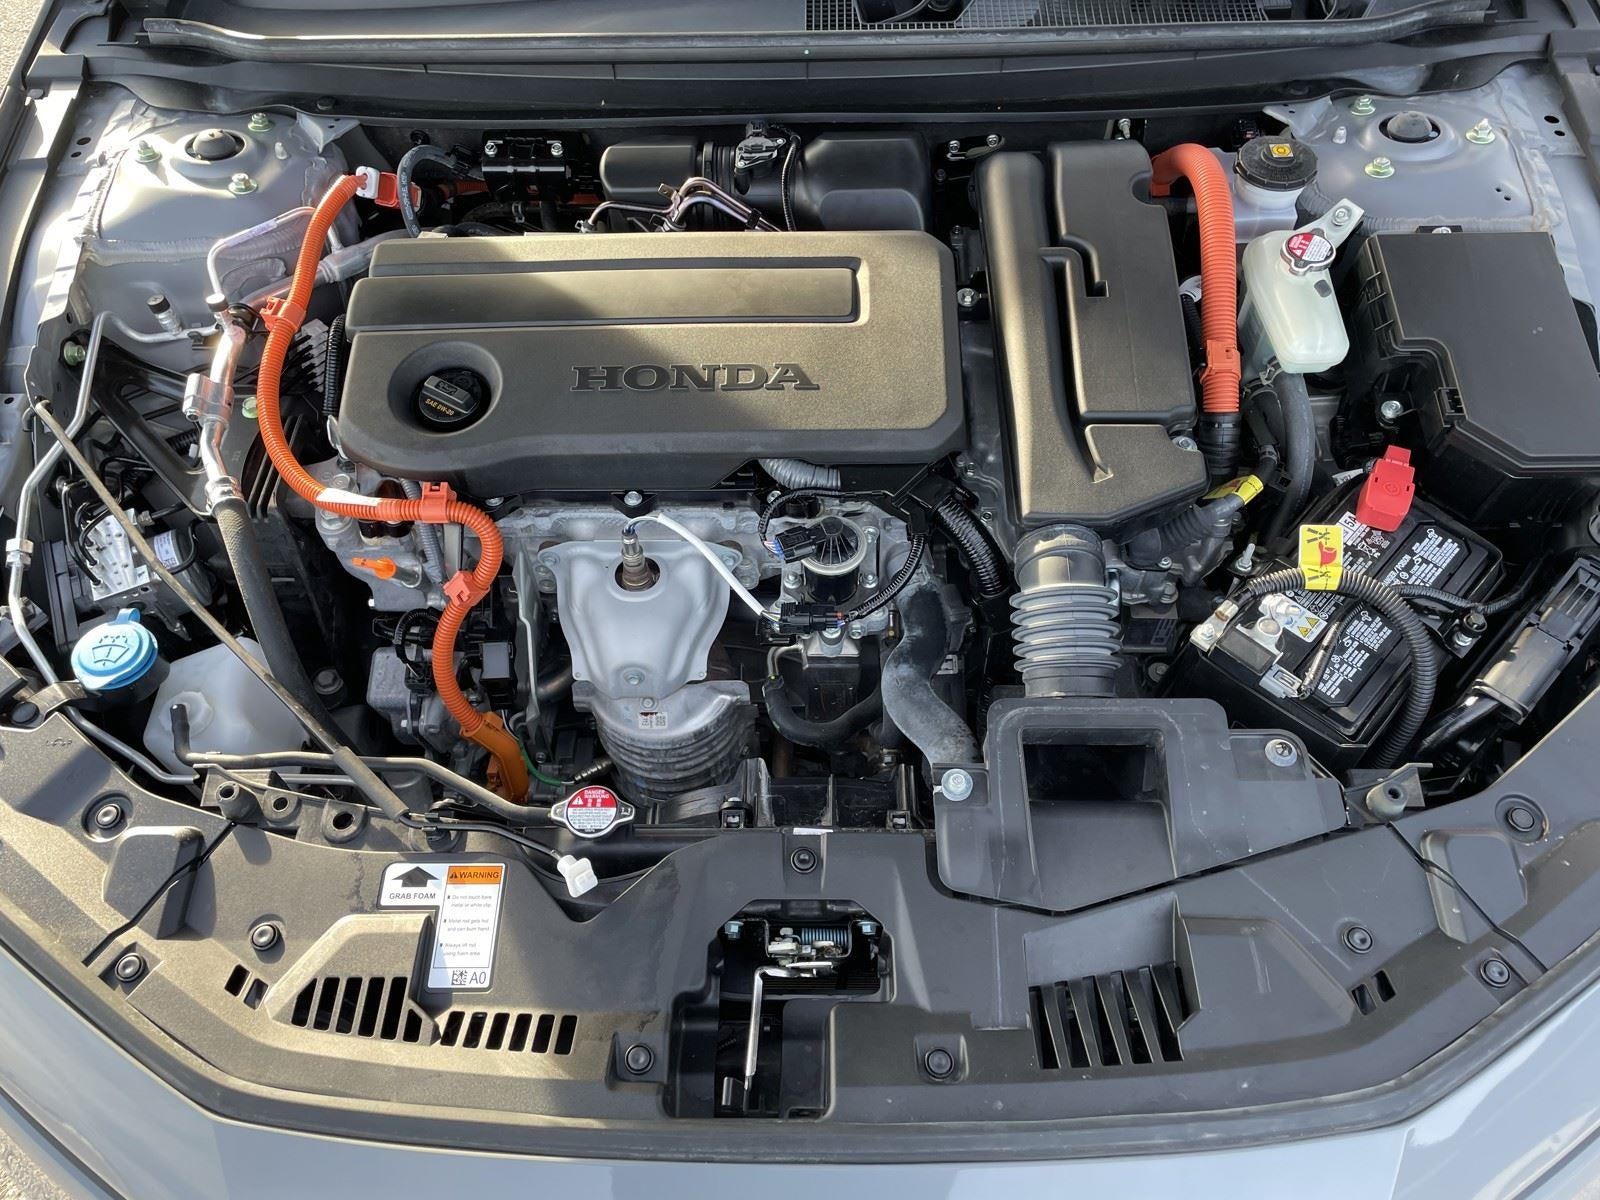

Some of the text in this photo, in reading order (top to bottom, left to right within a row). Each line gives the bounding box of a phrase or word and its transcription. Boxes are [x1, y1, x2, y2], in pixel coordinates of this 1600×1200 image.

[570, 362, 820, 392] HONDA
[425, 398, 455, 416] SAE 0W-20
[459, 871, 500, 879] WARNING
[389, 892, 436, 900] GRAB FOAM
[469, 971, 487, 985] A0
